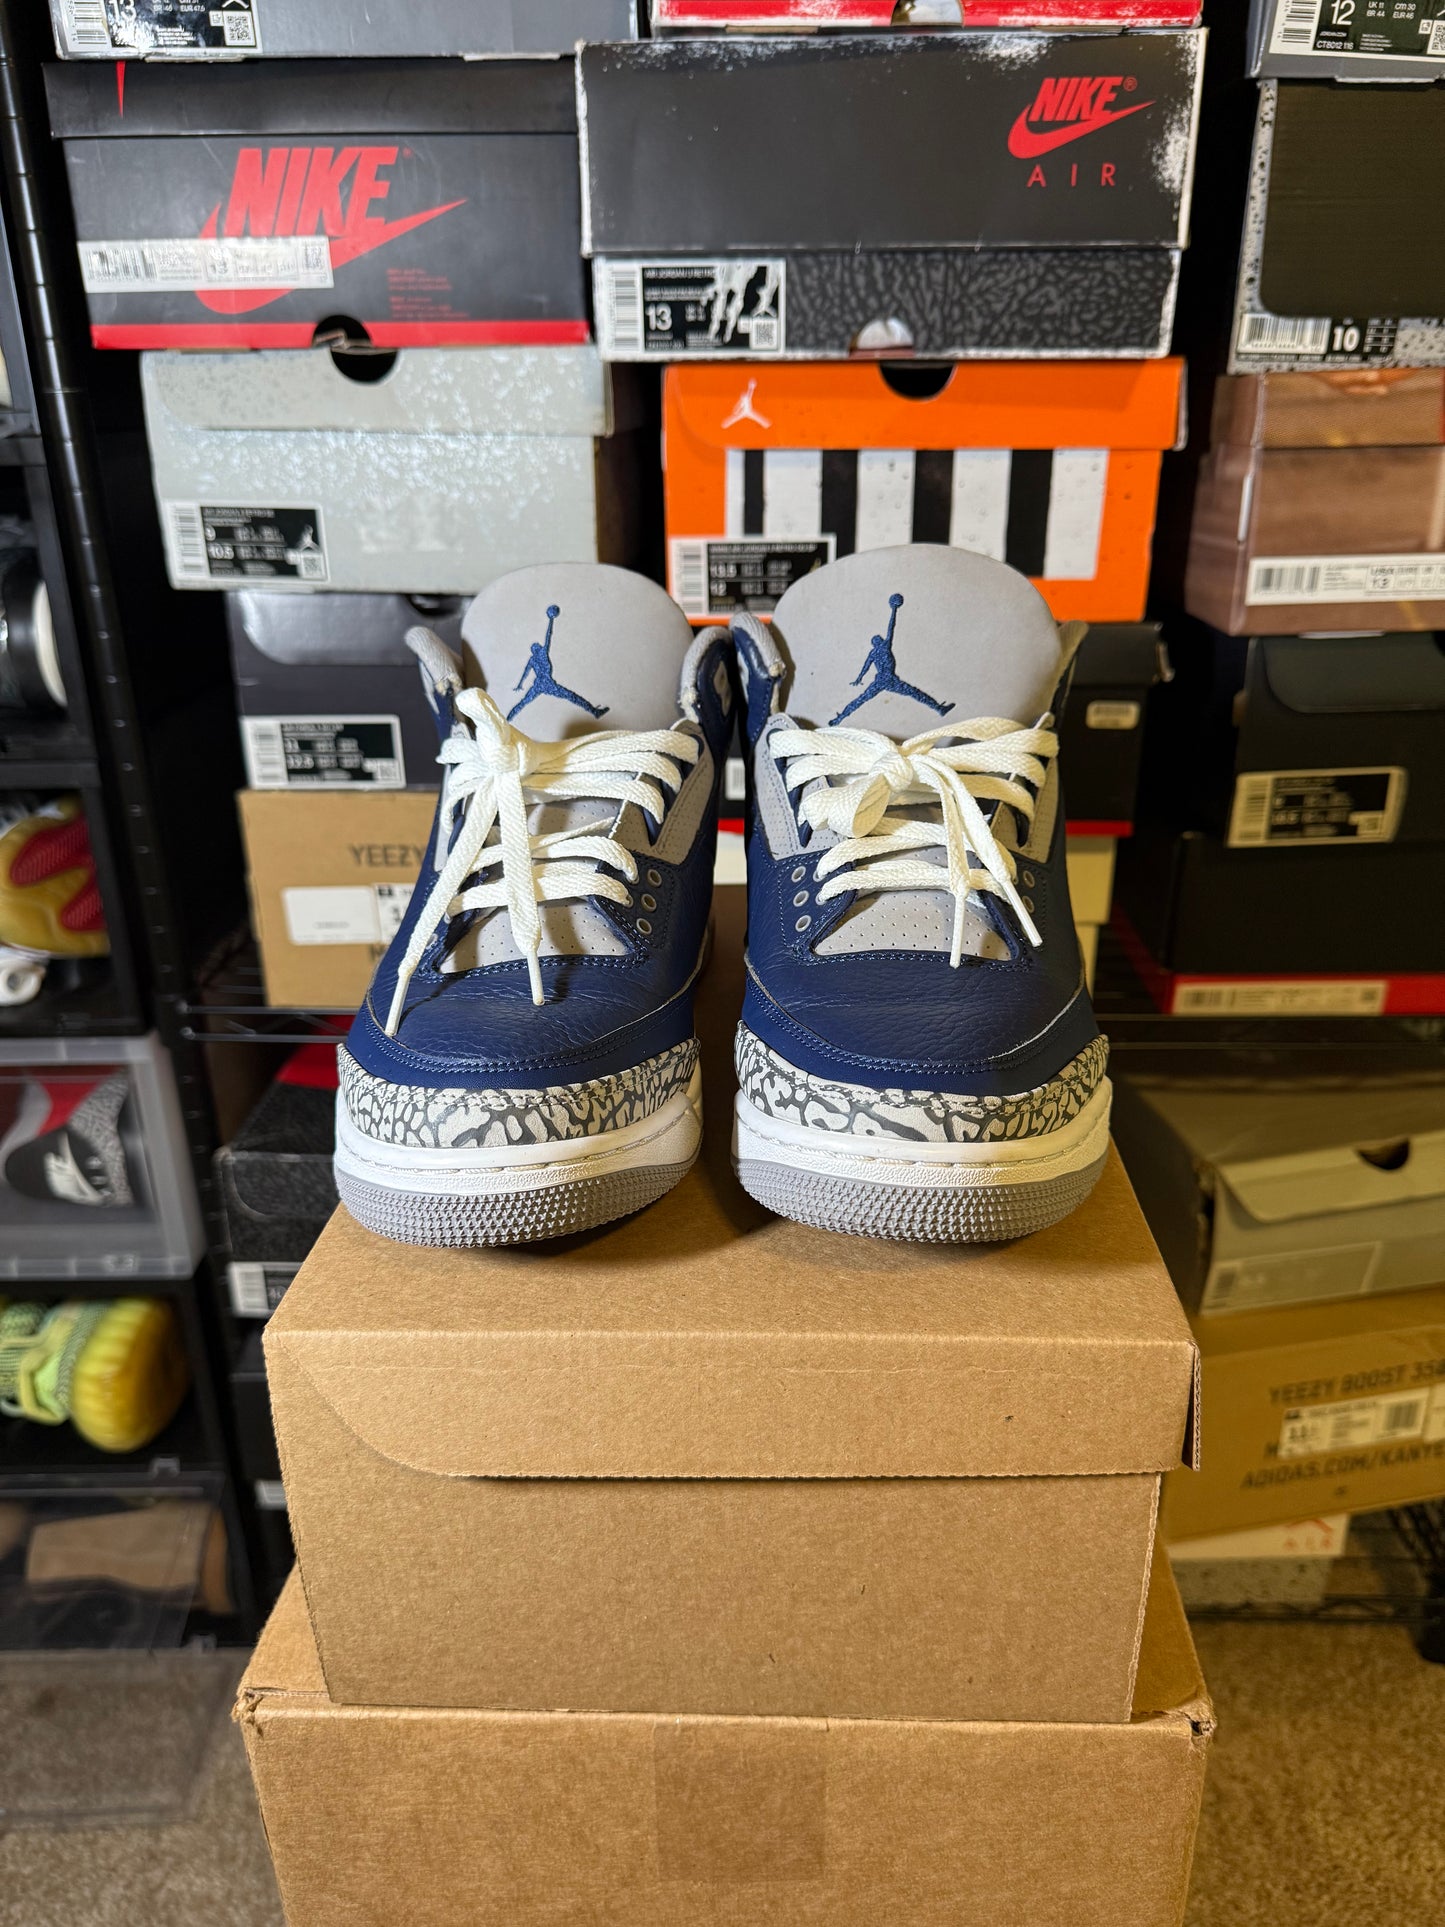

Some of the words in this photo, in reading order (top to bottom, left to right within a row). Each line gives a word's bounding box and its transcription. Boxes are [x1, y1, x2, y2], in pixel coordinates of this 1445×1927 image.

[109, 0, 137, 22] 13
[1331, 0, 1355, 26] 12
[1368, 1, 1378, 9] UK
[1392, 11, 1406, 19] EUR
[1407, 3, 1417, 11] 30
[1028, 76, 1123, 122] NIKE
[1027, 163, 1117, 188] AIR
[223, 147, 399, 238] NIKE
[645, 302, 673, 331] 13
[1332, 325, 1361, 352] 10
[1269, 1376, 1337, 1404] YEEZY
